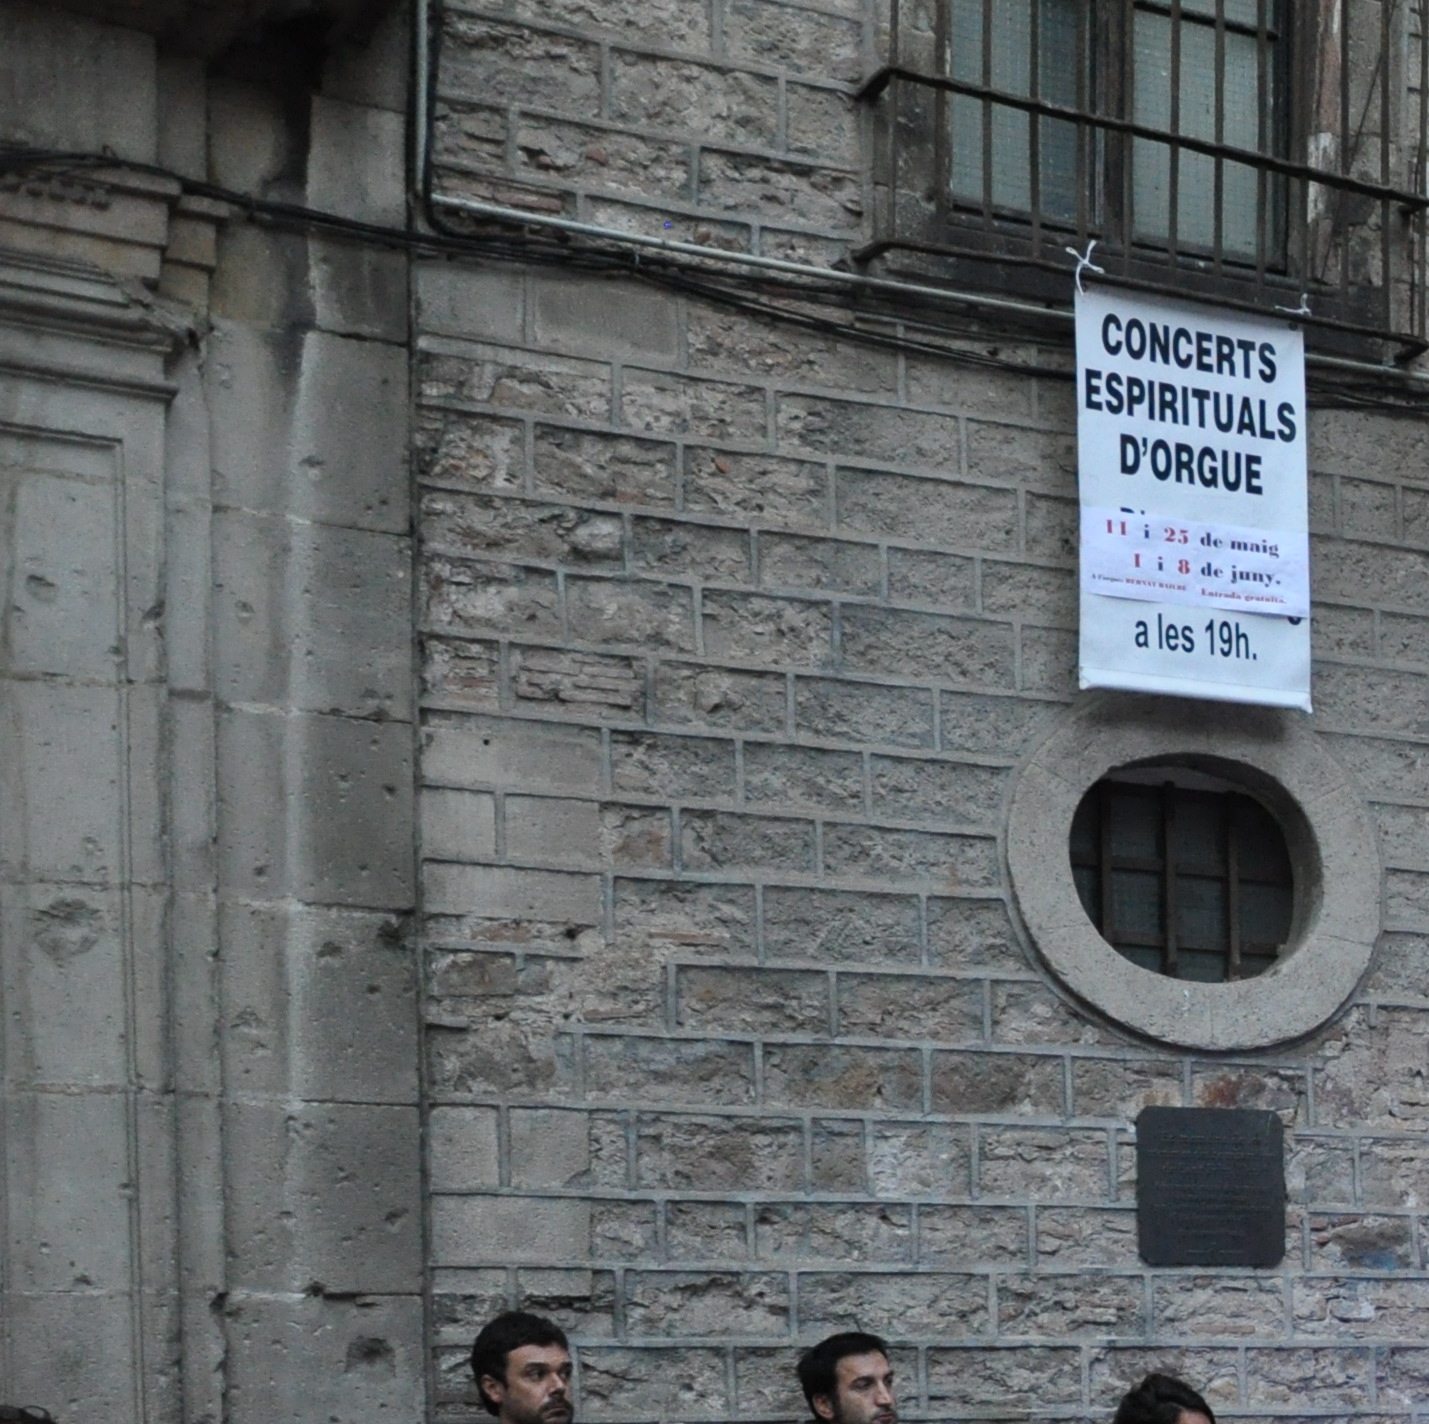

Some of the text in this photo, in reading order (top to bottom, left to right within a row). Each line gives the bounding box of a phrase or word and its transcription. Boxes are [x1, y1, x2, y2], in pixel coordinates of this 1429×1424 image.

[1101, 313, 1277, 384] CONCERTS
[1085, 368, 1297, 443] ESPIRITUALS
[1120, 433, 1263, 496] D'ORGUE
[1144, 524, 1150, 539] i
[1164, 527, 1189, 545] 25
[1200, 532, 1223, 548] de
[1230, 539, 1280, 559] maig
[1157, 556, 1164, 572] i
[1177, 559, 1191, 575] 8
[1200, 562, 1224, 578] de
[1230, 565, 1282, 588] juny.
[1134, 612, 1258, 661] a les 19h.
